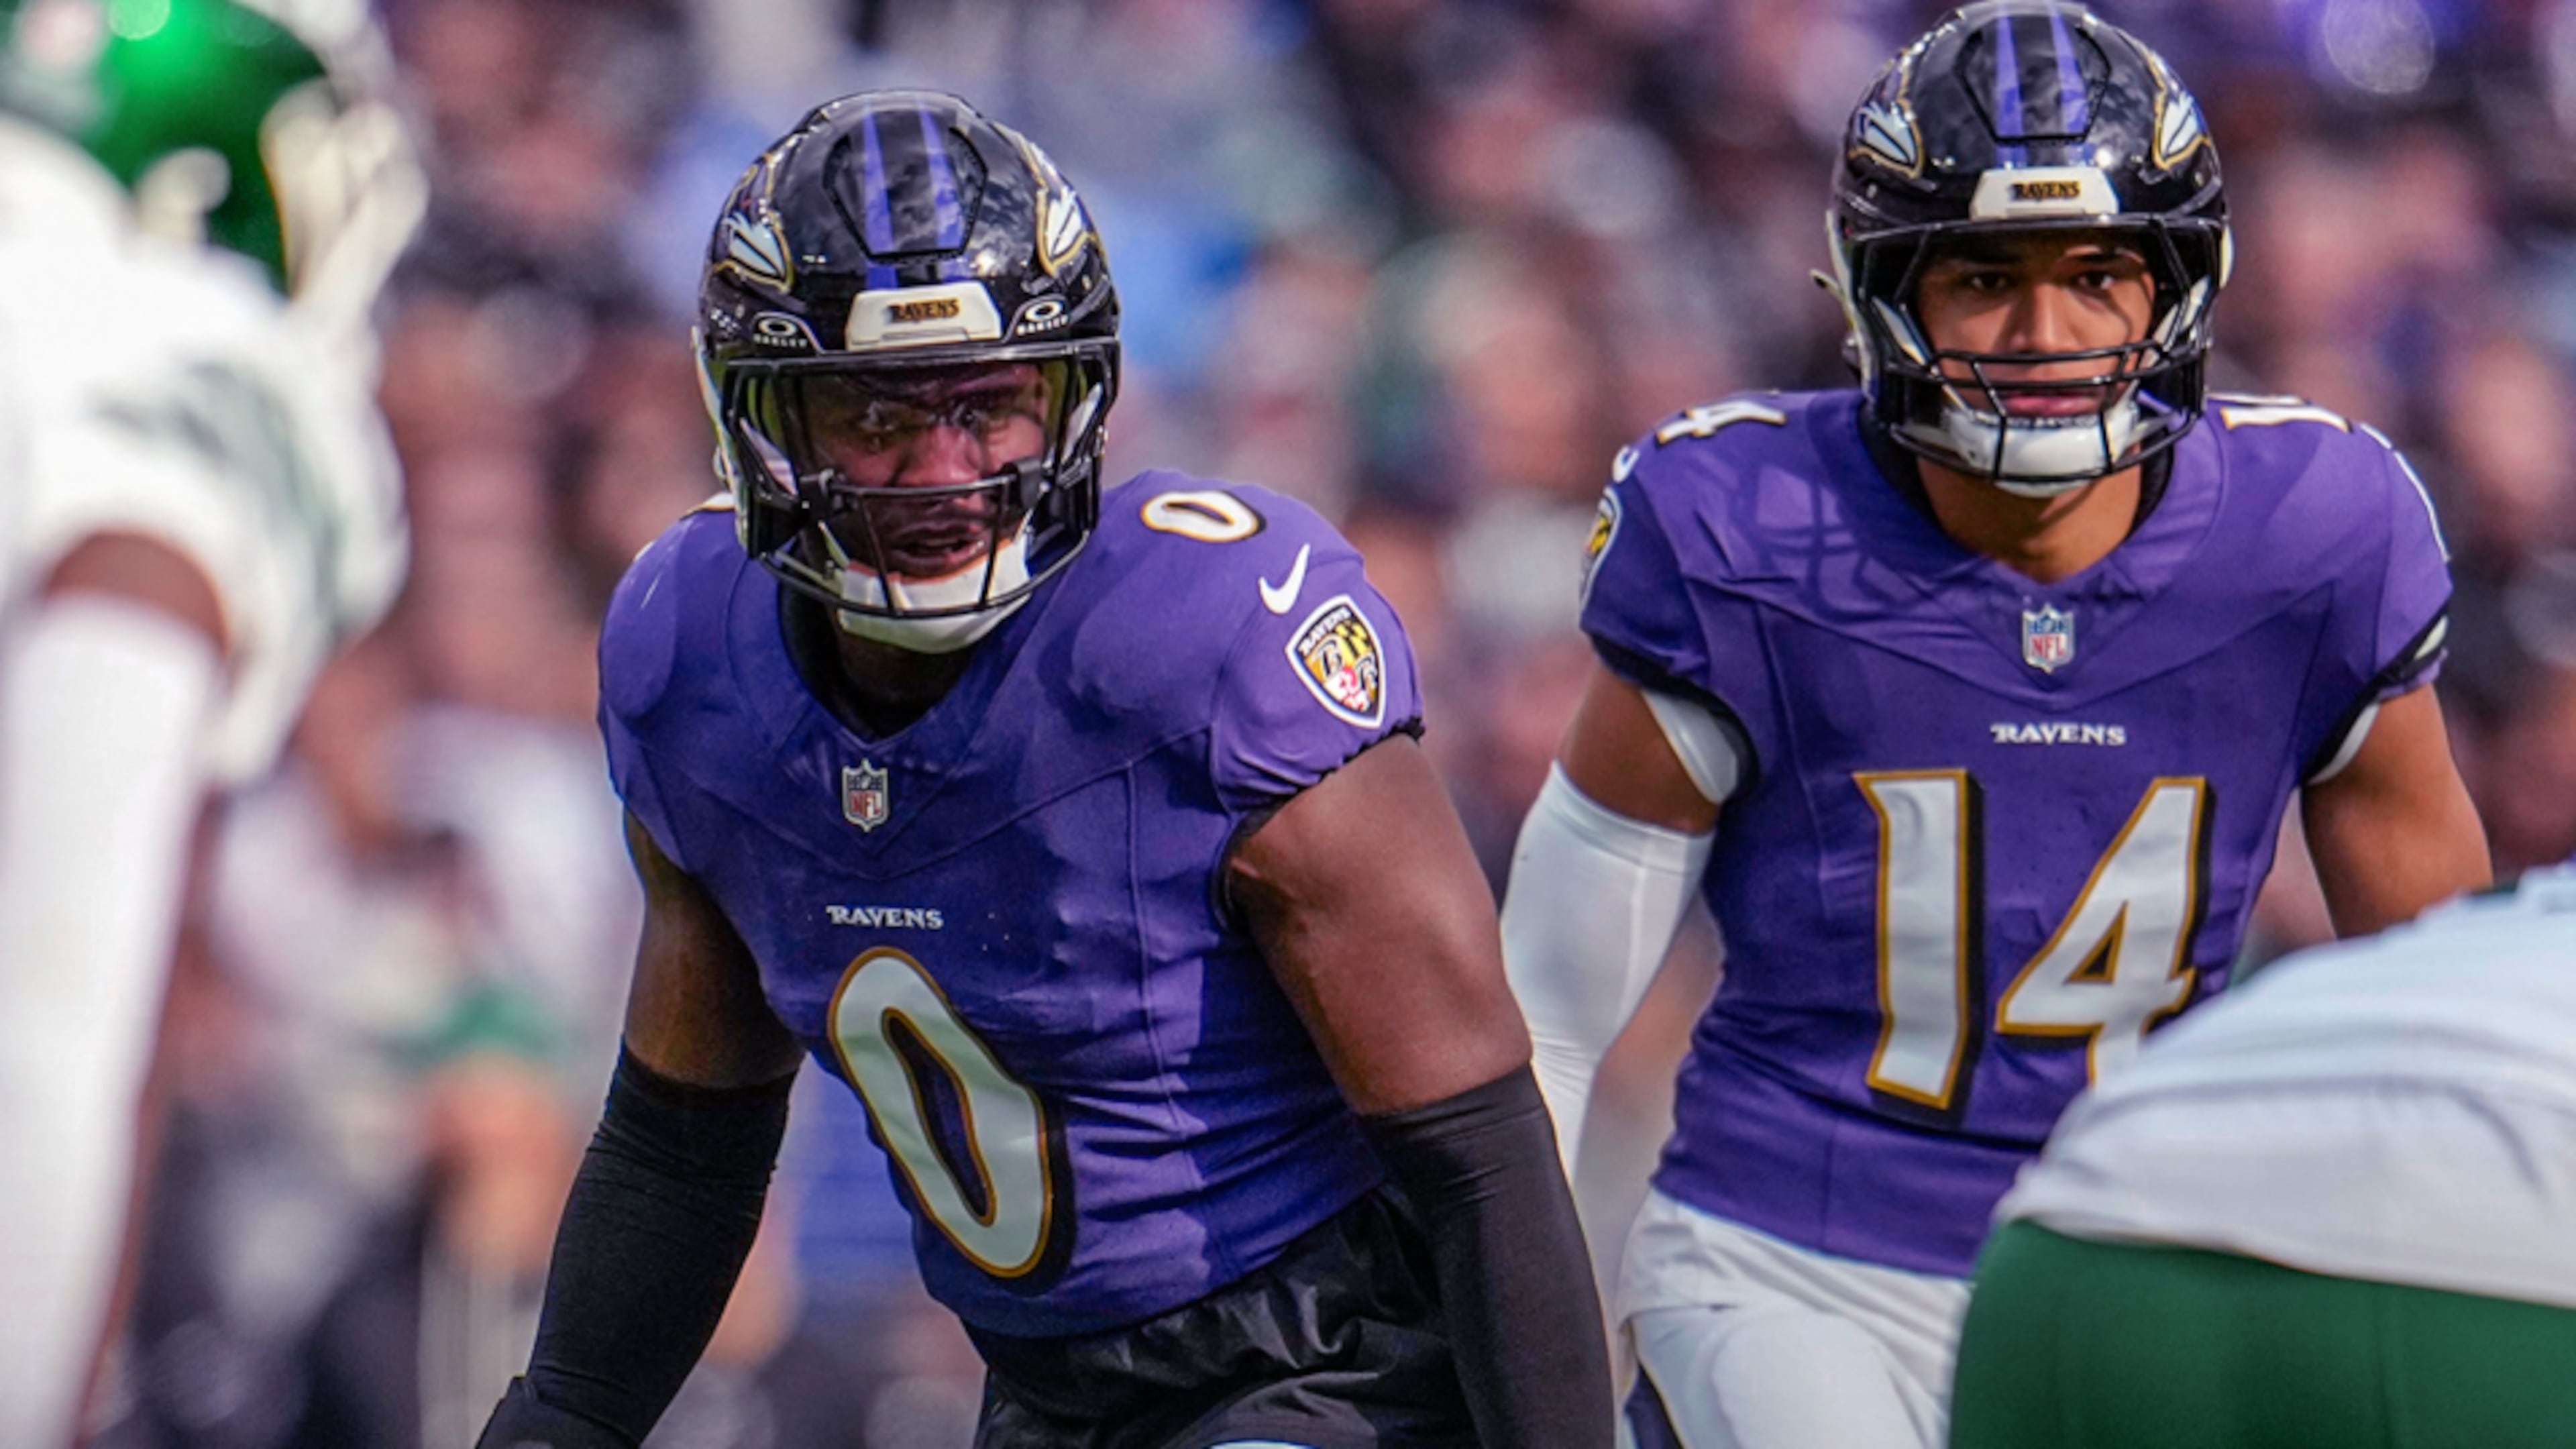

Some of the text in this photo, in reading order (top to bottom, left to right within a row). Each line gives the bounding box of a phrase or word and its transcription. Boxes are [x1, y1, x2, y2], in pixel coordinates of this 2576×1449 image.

[2012, 180, 2082, 202] RAVENS
[886, 297, 961, 323] RAVENS
[1015, 314, 1069, 337] OAKLEY
[753, 333, 808, 348] OAKLEY
[1141, 490, 1264, 543] 0
[2029, 633, 2068, 661] NFL
[1990, 722, 2127, 747] RAVENS
[849, 790, 883, 818] NFL
[825, 904, 944, 930] RAVENS
[1852, 767, 2212, 1114] 14
[826, 945, 1053, 1279] 0
